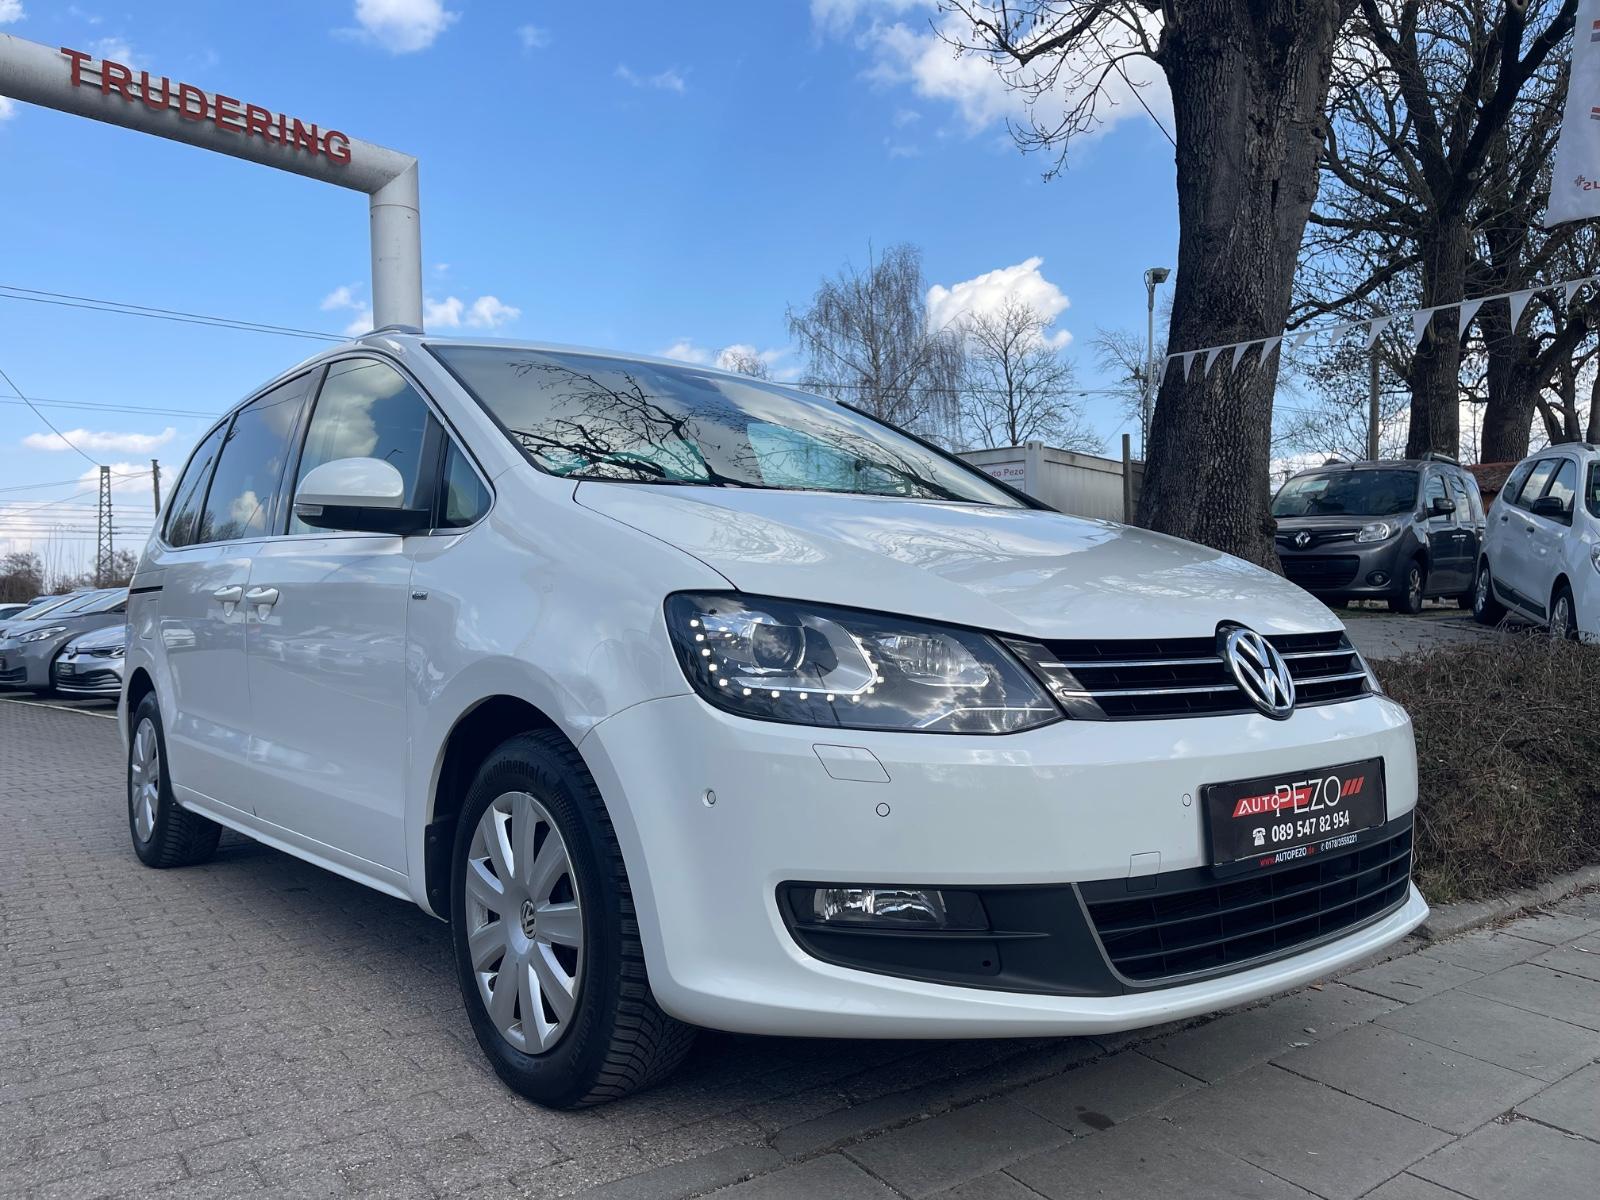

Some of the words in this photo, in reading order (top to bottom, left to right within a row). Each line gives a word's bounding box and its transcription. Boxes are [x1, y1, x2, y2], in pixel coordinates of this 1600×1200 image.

[60, 46, 352, 165] TRUDERING
[1003, 468, 1024, 477] Pezo
[1271, 823, 1294, 842] 089
[1296, 818, 1317, 837] 547
[1319, 814, 1332, 832] 82
[1333, 809, 1350, 830] 954
